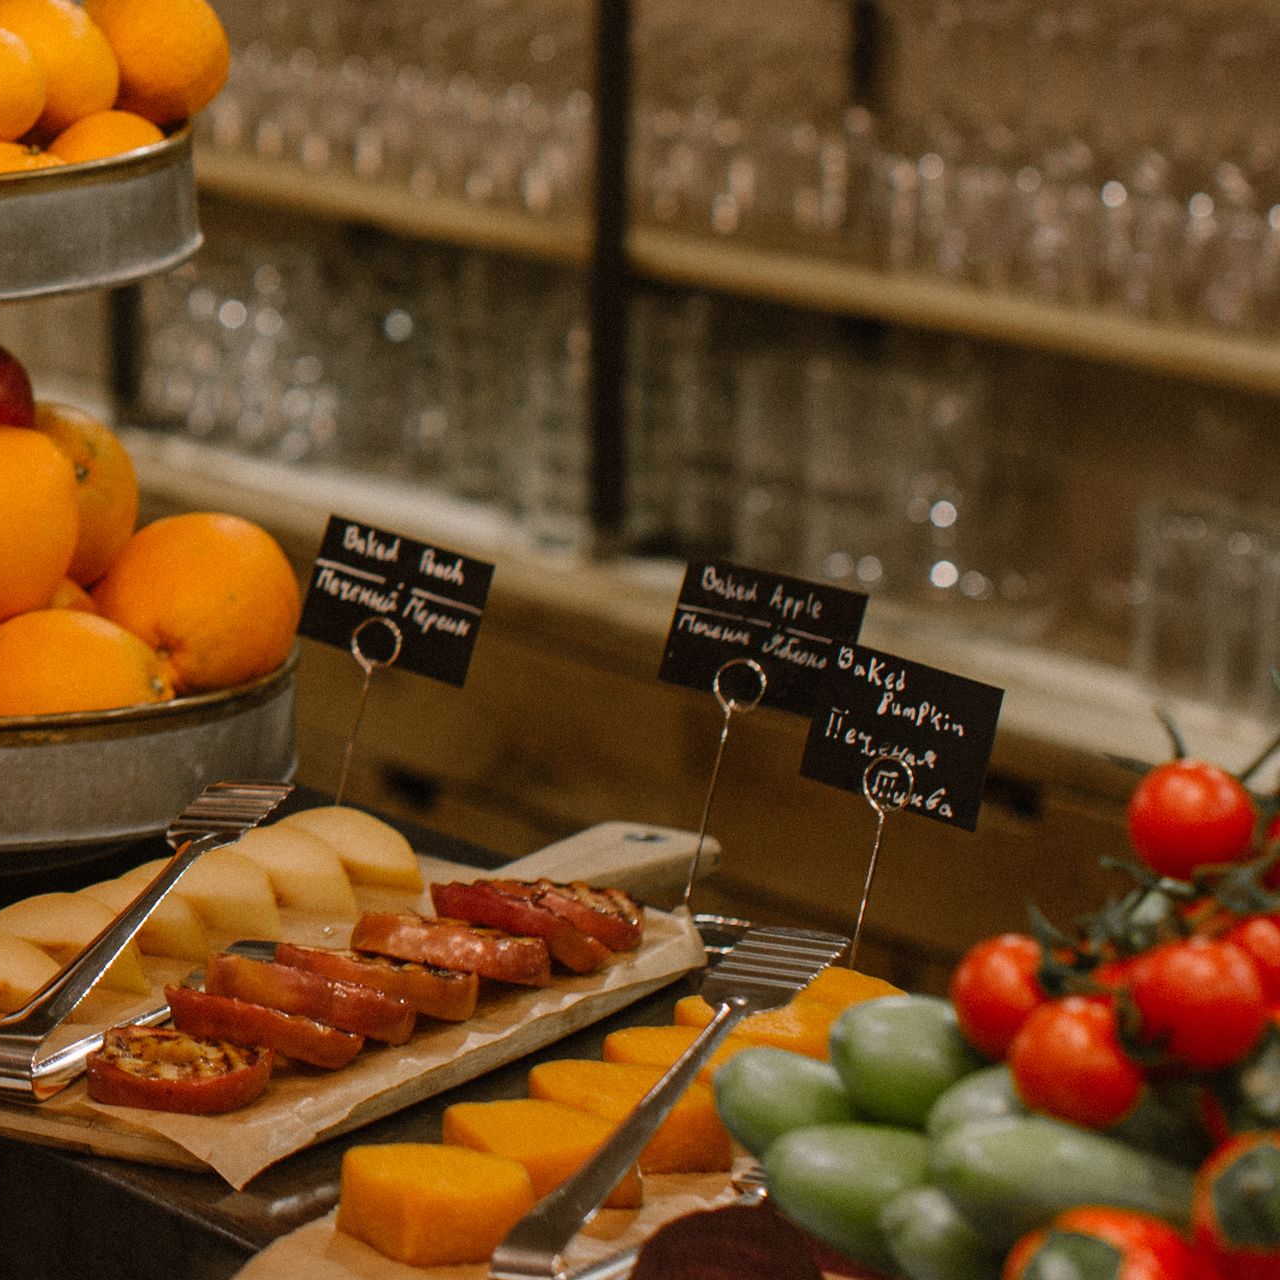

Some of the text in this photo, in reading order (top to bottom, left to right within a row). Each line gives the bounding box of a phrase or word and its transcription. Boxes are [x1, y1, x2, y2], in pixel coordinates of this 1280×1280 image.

[343, 525, 400, 562] Baked
[702, 565, 823, 620] Baked Apple
